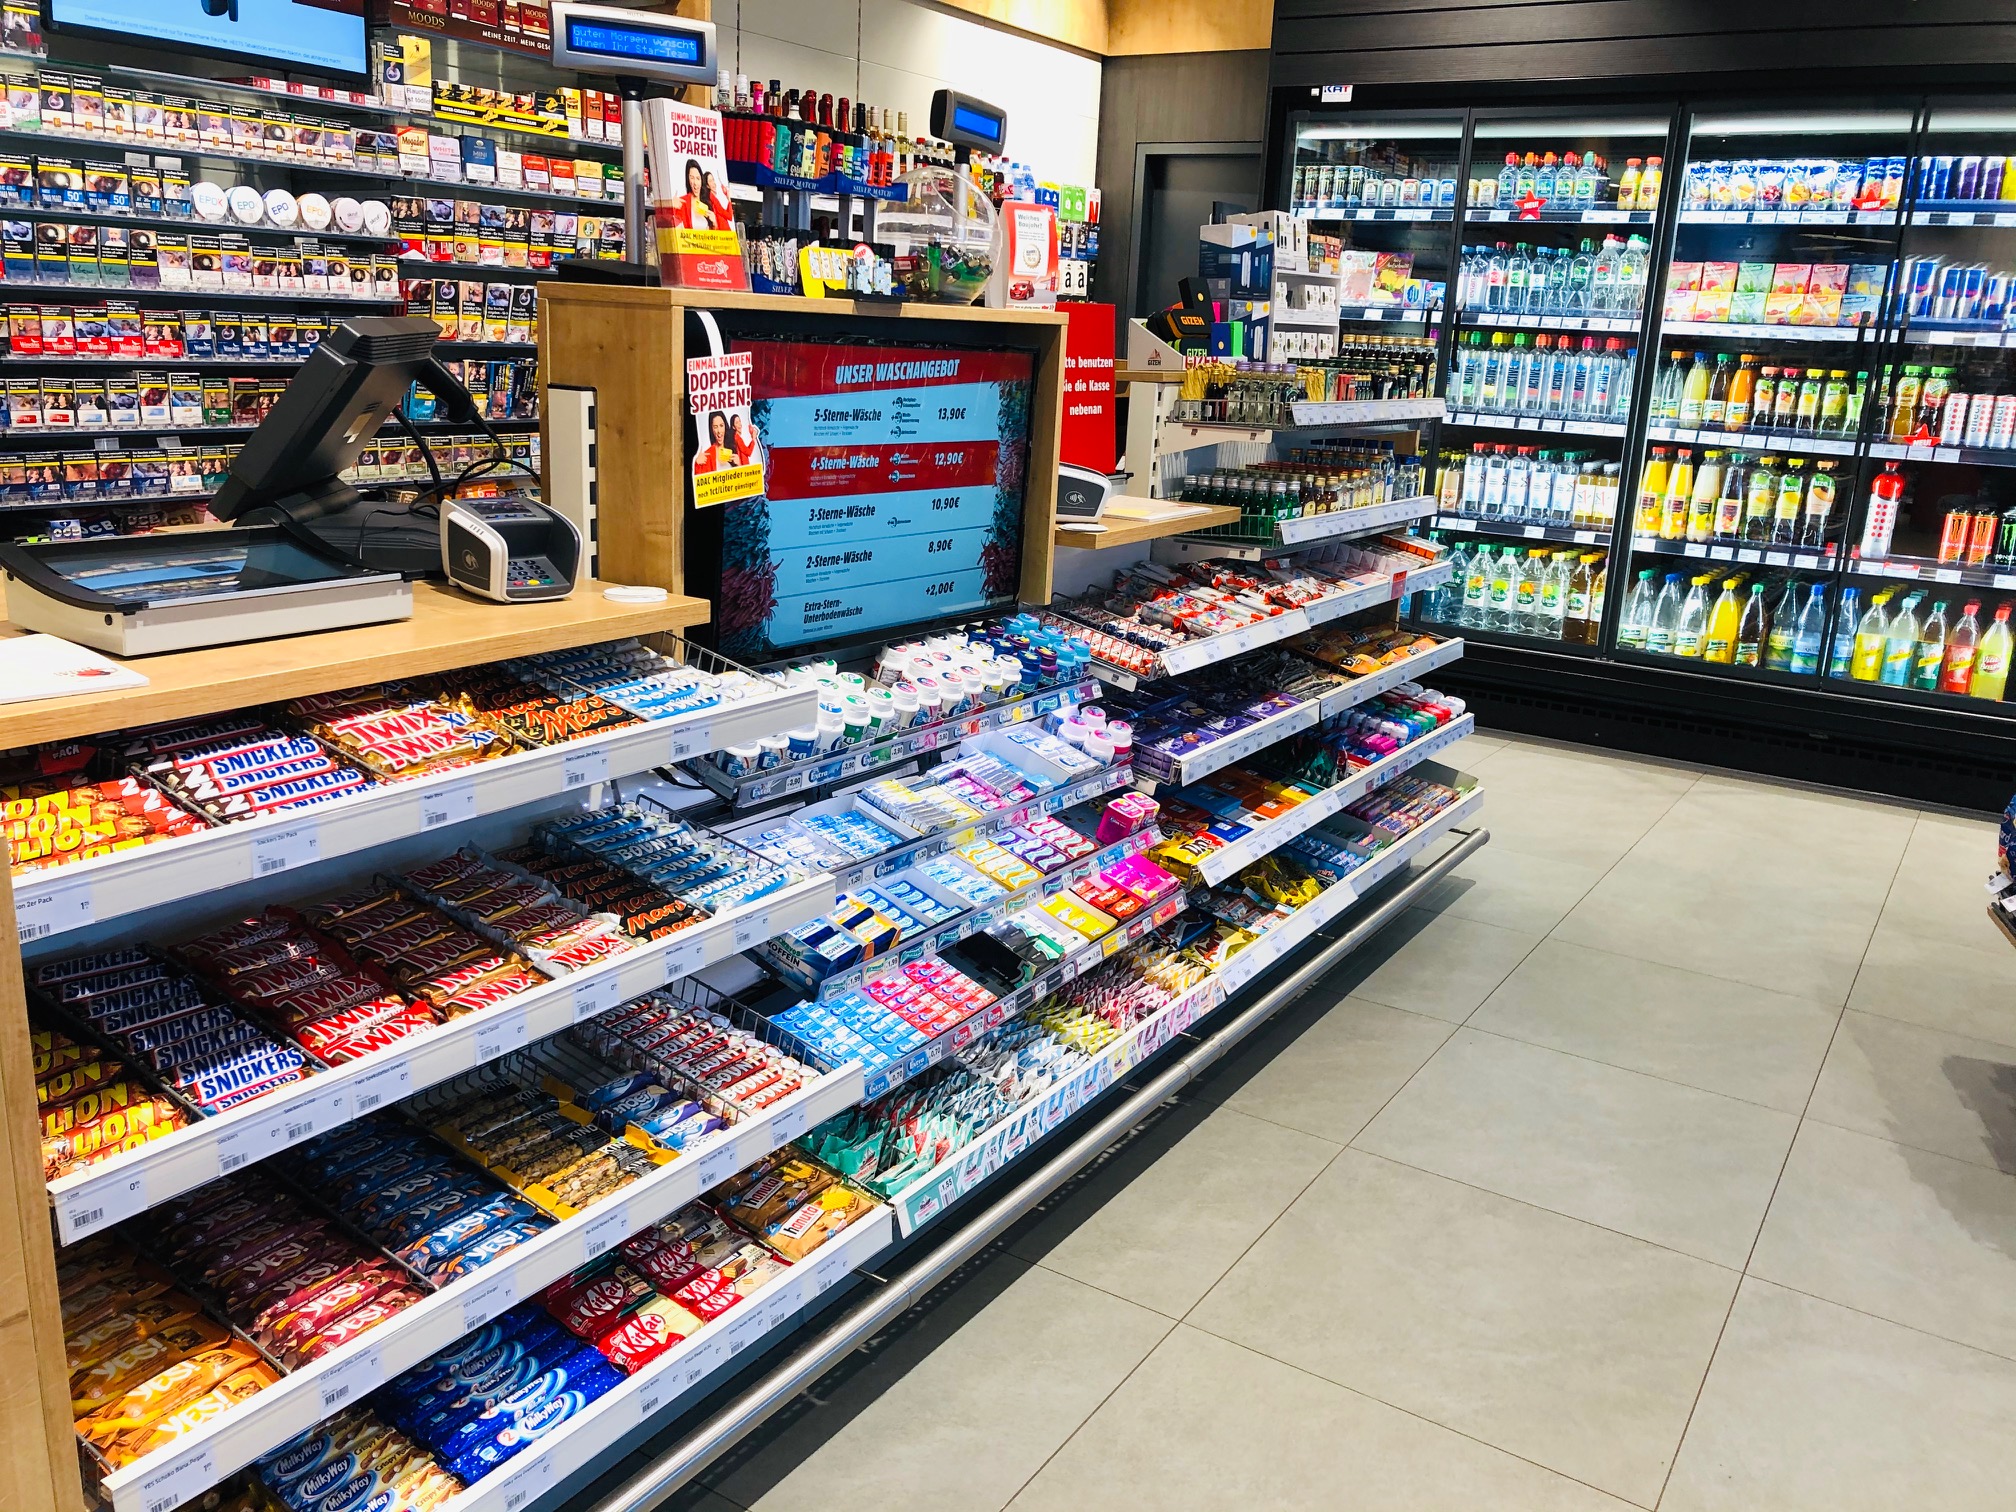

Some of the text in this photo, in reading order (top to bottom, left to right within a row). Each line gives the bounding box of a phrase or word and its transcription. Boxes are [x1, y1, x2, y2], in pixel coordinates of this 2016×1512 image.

[408, 10, 445, 28] MOODS
[524, 8, 548, 19] MOODS
[482, 30, 502, 40] MEINE
[504, 34, 518, 44] ZEIT.
[520, 39, 536, 48] MEIN
[573, 26, 695, 51] Guten Morgen wünscht
[574, 38, 689, 59] Ihnen Ihr Star-Team
[671, 112, 717, 127] EINMAL TANKEN
[672, 122, 718, 142] DOPPELT
[472, 150, 488, 159] MINI
[673, 139, 718, 159] SPAREN!
[774, 176, 818, 190] SILVER MATCH
[852, 184, 893, 198] SILVER MATCH
[1524, 200, 1539, 210] NEU!
[1862, 200, 1881, 210] NEU!
[1018, 214, 1040, 222] Welches
[692, 232, 718, 241] Mitglieder
[697, 261, 717, 274] star
[772, 286, 794, 295] SILVER
[1180, 316, 1206, 326] GIZEH
[52, 342, 74, 351] Winston
[87, 342, 109, 350] Winston
[120, 342, 142, 352] Winston
[1186, 348, 1208, 357] GIZEH
[688, 354, 751, 372] EINMAL TANKEN
[836, 359, 960, 385] UNSER WASCHANGEBOT
[1078, 356, 1114, 369] benutzen
[1464, 364, 1474, 384] ACTIVE
[690, 367, 751, 393] DOPPELT
[1074, 379, 1111, 392] die Kasse
[1485, 365, 1498, 386] ACTIVE
[1506, 365, 1520, 388] ACTIVE
[1528, 368, 1541, 389] ACTIVE
[1552, 368, 1565, 391] ACTIVE
[692, 388, 751, 414] SPAREN!
[1070, 403, 1103, 416] nebenan
[814, 408, 967, 423] 5-Sterne-Wäsche 13,90€
[1912, 438, 1932, 447] NEU!
[810, 454, 880, 471] 4-Sterne-Wäsche
[934, 452, 964, 466] 12,90€
[696, 476, 711, 487] ADAC
[712, 472, 743, 484] Mitglieder
[698, 480, 760, 499] noch 1ct/Liter günstiger!
[809, 496, 960, 522] 3-Sterne-Wäsche 10,90€
[806, 538, 954, 569] 2-Sterne-Wäsche 8,90€
[804, 581, 955, 613] Extra-Stern- +2,00€
[804, 606, 863, 625] Unterbodenwäsche
[526, 696, 605, 728] Mars
[544, 706, 623, 740] Mars
[334, 710, 442, 745] TWIX
[213, 737, 316, 775] SNICKERS
[258, 768, 360, 804] SNICKERS
[556, 804, 623, 829] BOUNTY
[18, 821, 117, 862] LION
[286, 831, 298, 839] Pack
[620, 834, 683, 860] BOUNTY
[731, 867, 789, 901] BOUNTY
[26, 896, 53, 909] 2er Pack
[627, 900, 687, 936] Mars
[794, 922, 816, 936] KOFFEIN
[545, 934, 621, 971] TWIX
[766, 940, 801, 968] KOFFEIN
[824, 942, 848, 956] KOFFEIN
[274, 972, 377, 1016] TWIX
[444, 970, 536, 1012] TWIX
[829, 988, 846, 998] KOFFEIN
[131, 1005, 235, 1051] SNICKERS
[309, 997, 396, 1042] TWIX
[325, 1014, 426, 1062] TWIX
[634, 1013, 695, 1050] BOUNTY
[157, 1021, 262, 1070] SNICKERS
[201, 1049, 303, 1100] SNICKERS
[707, 1052, 768, 1091] BOUNTY
[480, 1078, 514, 1094] KIND
[46, 1082, 128, 1138] LION
[73, 1101, 155, 1157] LION
[217, 1133, 239, 1146] Snickers
[566, 1124, 599, 1141] KIND
[381, 1174, 439, 1200] YES!
[748, 1177, 780, 1205] hanuta
[410, 1191, 468, 1220] YES!
[433, 1210, 491, 1242] YES!
[784, 1203, 821, 1235] hanuta
[465, 1230, 523, 1260] YES!
[684, 1226, 710, 1242] CHUNKY
[300, 1280, 366, 1318] YES!
[580, 1279, 624, 1318] KitKat
[322, 1304, 391, 1340] YES!
[619, 1315, 666, 1355] KitKat
[462, 1348, 501, 1378] MilkyWay
[126, 1360, 202, 1402] YES!
[522, 1397, 563, 1431] MilkyWay
[354, 1438, 376, 1456] Crispy
[502, 1432, 514, 1444] 2
[280, 1440, 323, 1474] MilkyWay
[374, 1455, 397, 1472] Crispy
[304, 1459, 349, 1496] MilkyWay
[326, 1476, 370, 1512] MilkyWay
[416, 1477, 455, 1508] Crispy Rolls
